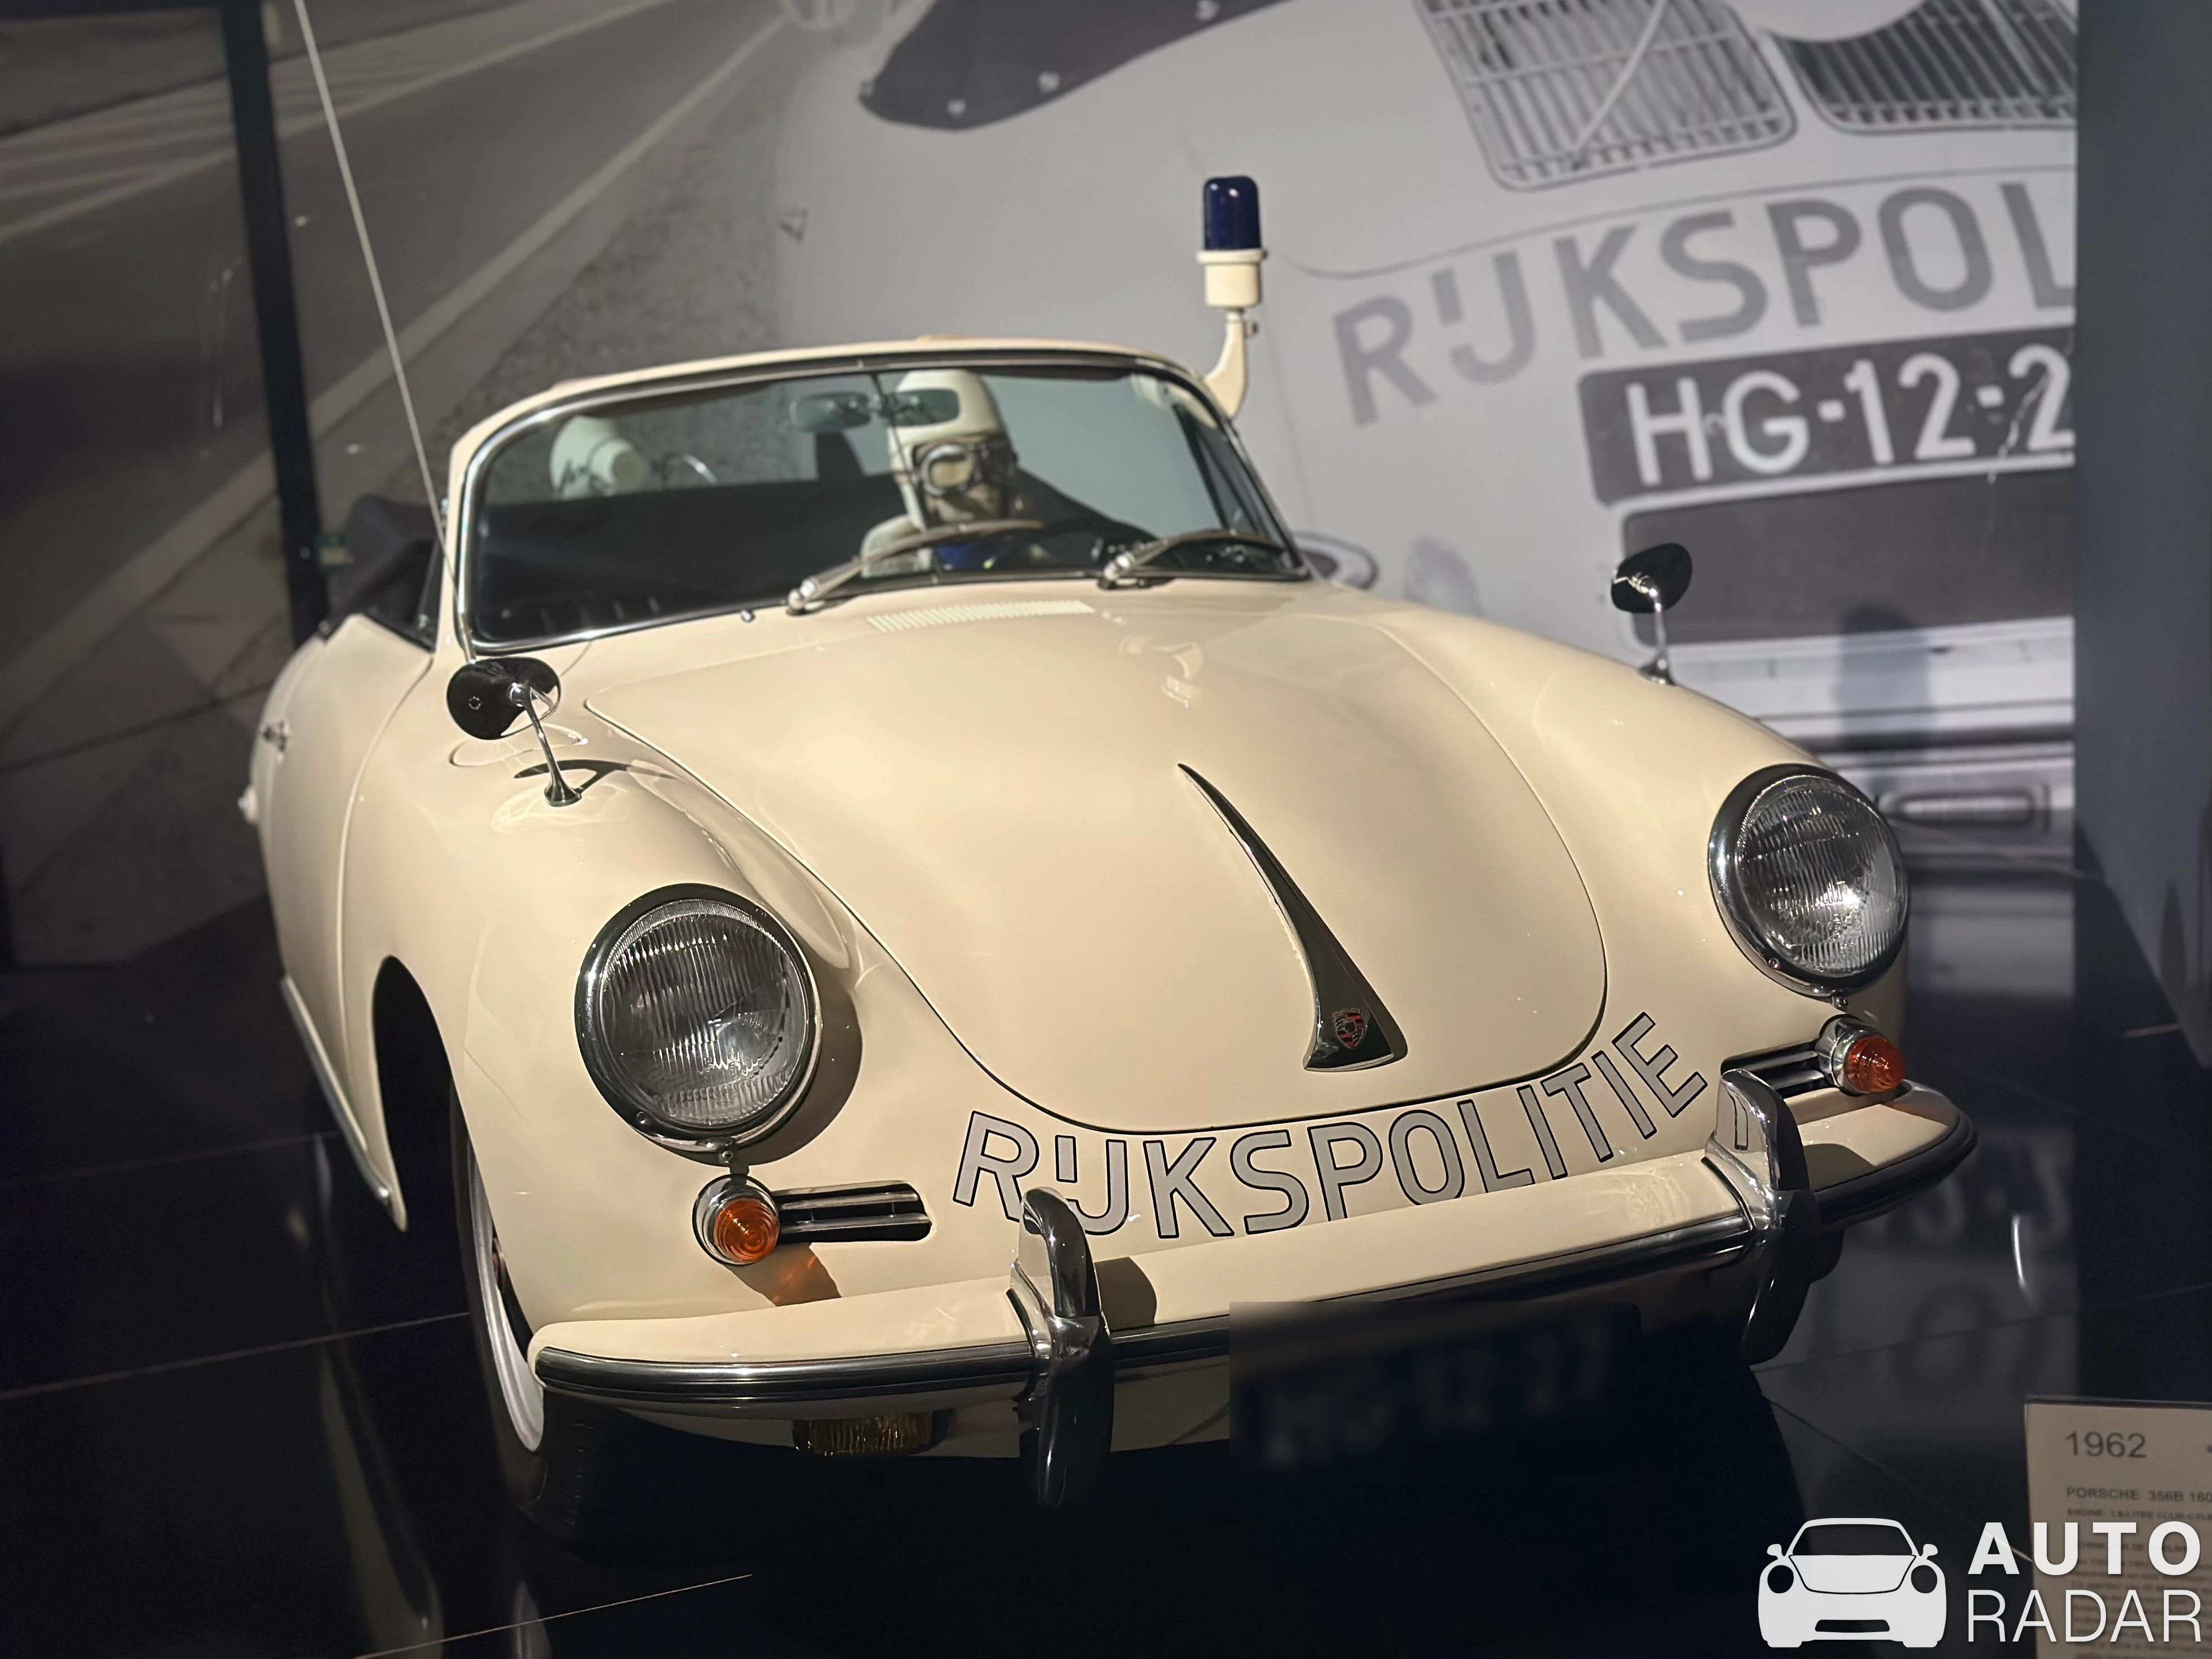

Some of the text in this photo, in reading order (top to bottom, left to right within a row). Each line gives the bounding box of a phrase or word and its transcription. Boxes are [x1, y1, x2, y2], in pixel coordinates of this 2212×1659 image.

[953, 1011, 1708, 1240] RIJKSPOLITIE
[2065, 1430, 2147, 1458] 1962
[2066, 1487, 2139, 1501] PORSCHE
[2148, 1490, 2184, 1502] 356B
